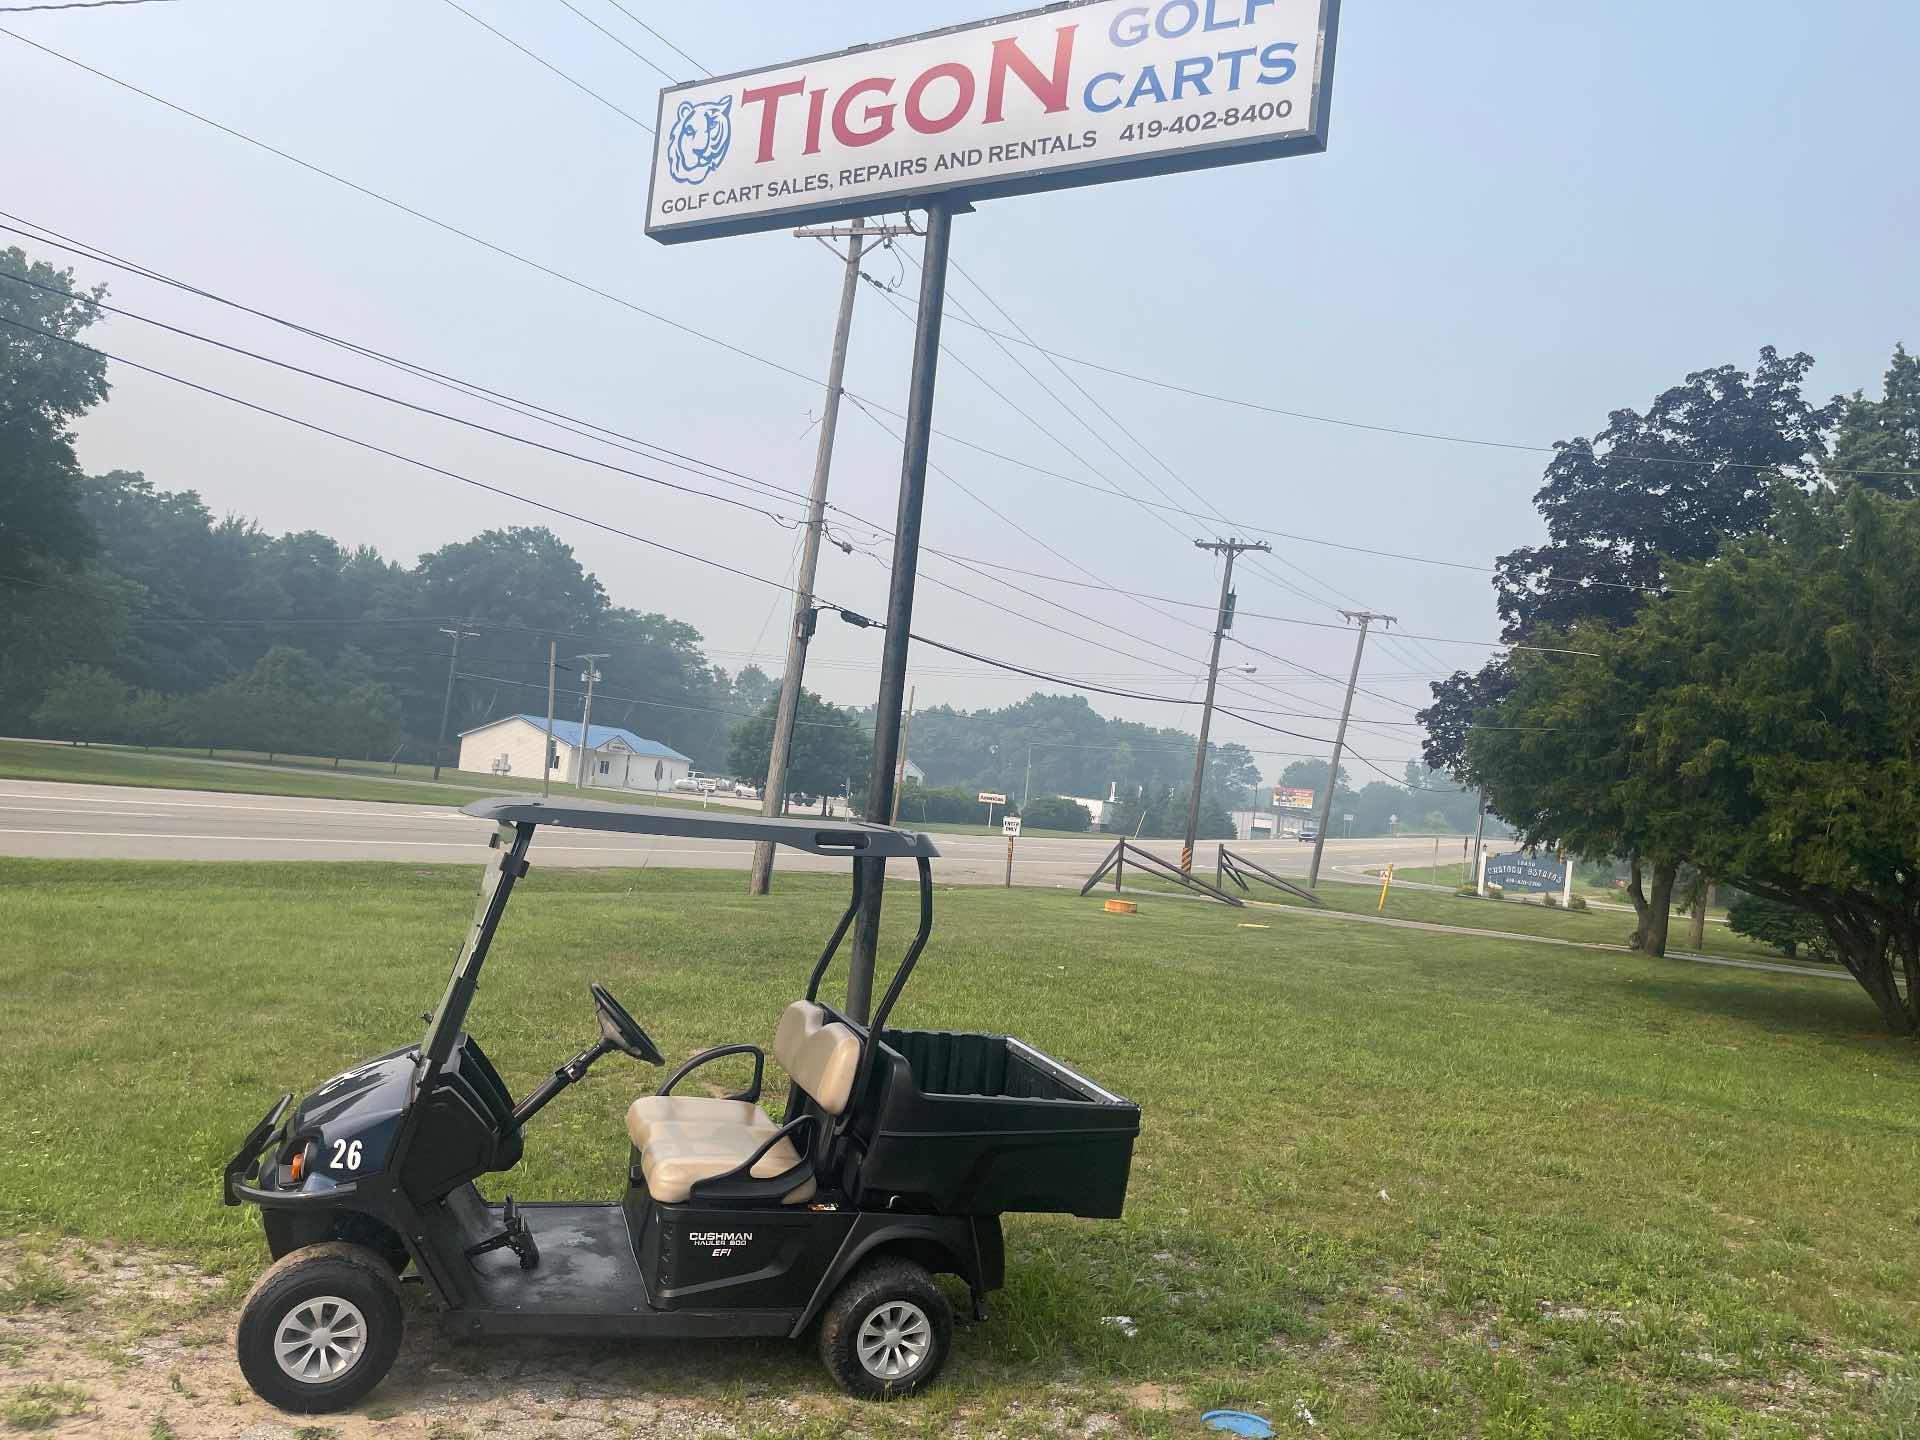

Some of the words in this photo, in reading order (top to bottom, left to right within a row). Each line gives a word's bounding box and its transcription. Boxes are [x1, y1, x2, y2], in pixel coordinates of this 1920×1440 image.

[740, 23, 1080, 164] TIGON
[1083, 42, 1298, 114] CARTS
[1119, 99, 1293, 142] 419-402-8400
[661, 193, 709, 215] GOLF
[712, 184, 764, 206] CART
[767, 172, 834, 198] SALES,
[839, 157, 928, 186] REPAIRS
[934, 147, 983, 172] AND
[988, 130, 1097, 164] RENTALS
[329, 1138, 363, 1171] 26
[689, 1232, 753, 1241] CUSHMAN
[711, 1248, 732, 1257] EFI
